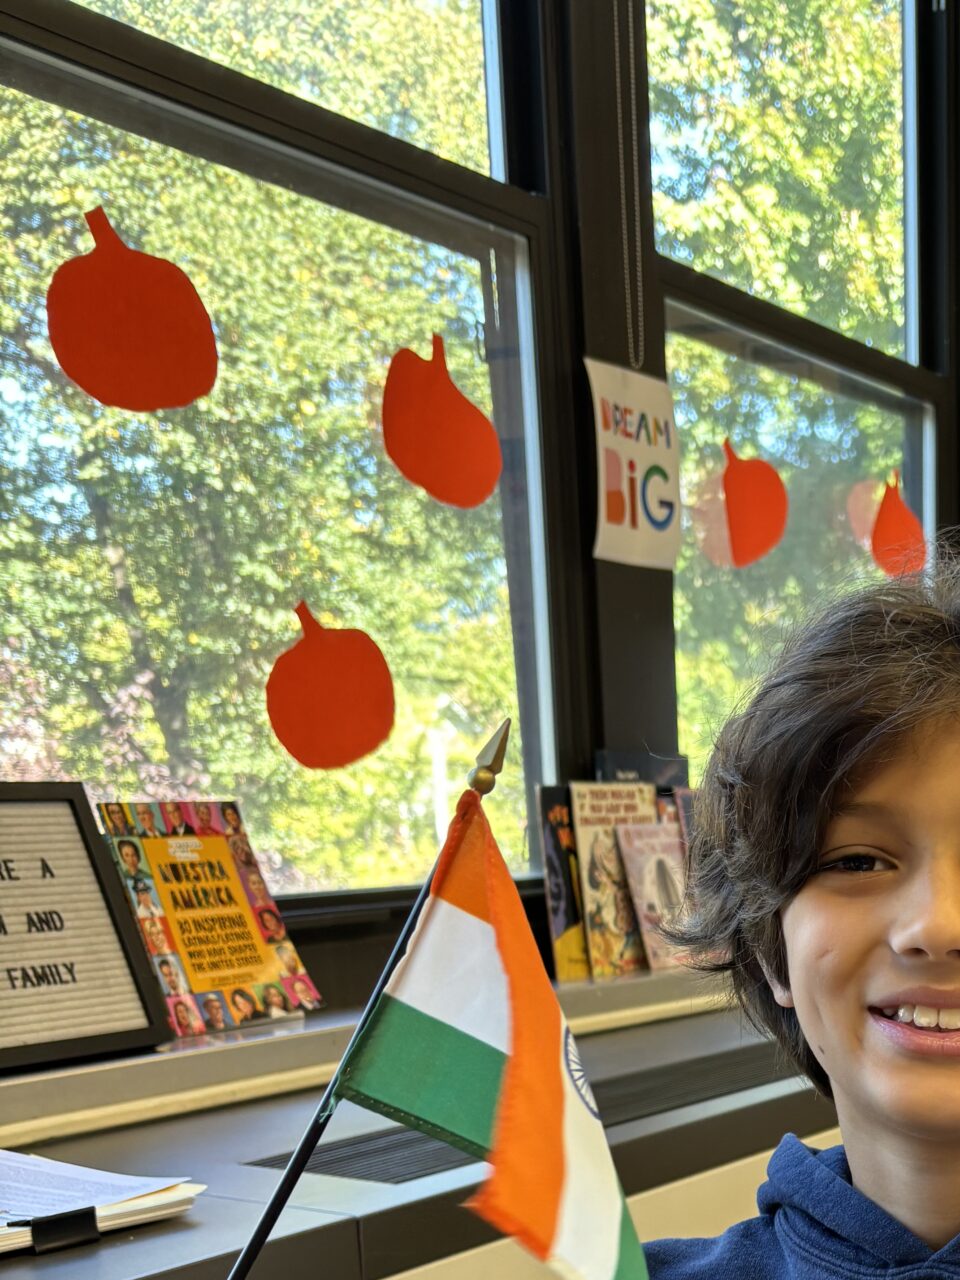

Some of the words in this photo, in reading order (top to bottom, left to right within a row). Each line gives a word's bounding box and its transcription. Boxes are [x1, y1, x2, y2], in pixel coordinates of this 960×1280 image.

[600, 397, 671, 449] DREAM
[40, 857, 55, 879] A
[26, 910, 64, 933] AND
[6, 962, 77, 990] FAMILY
